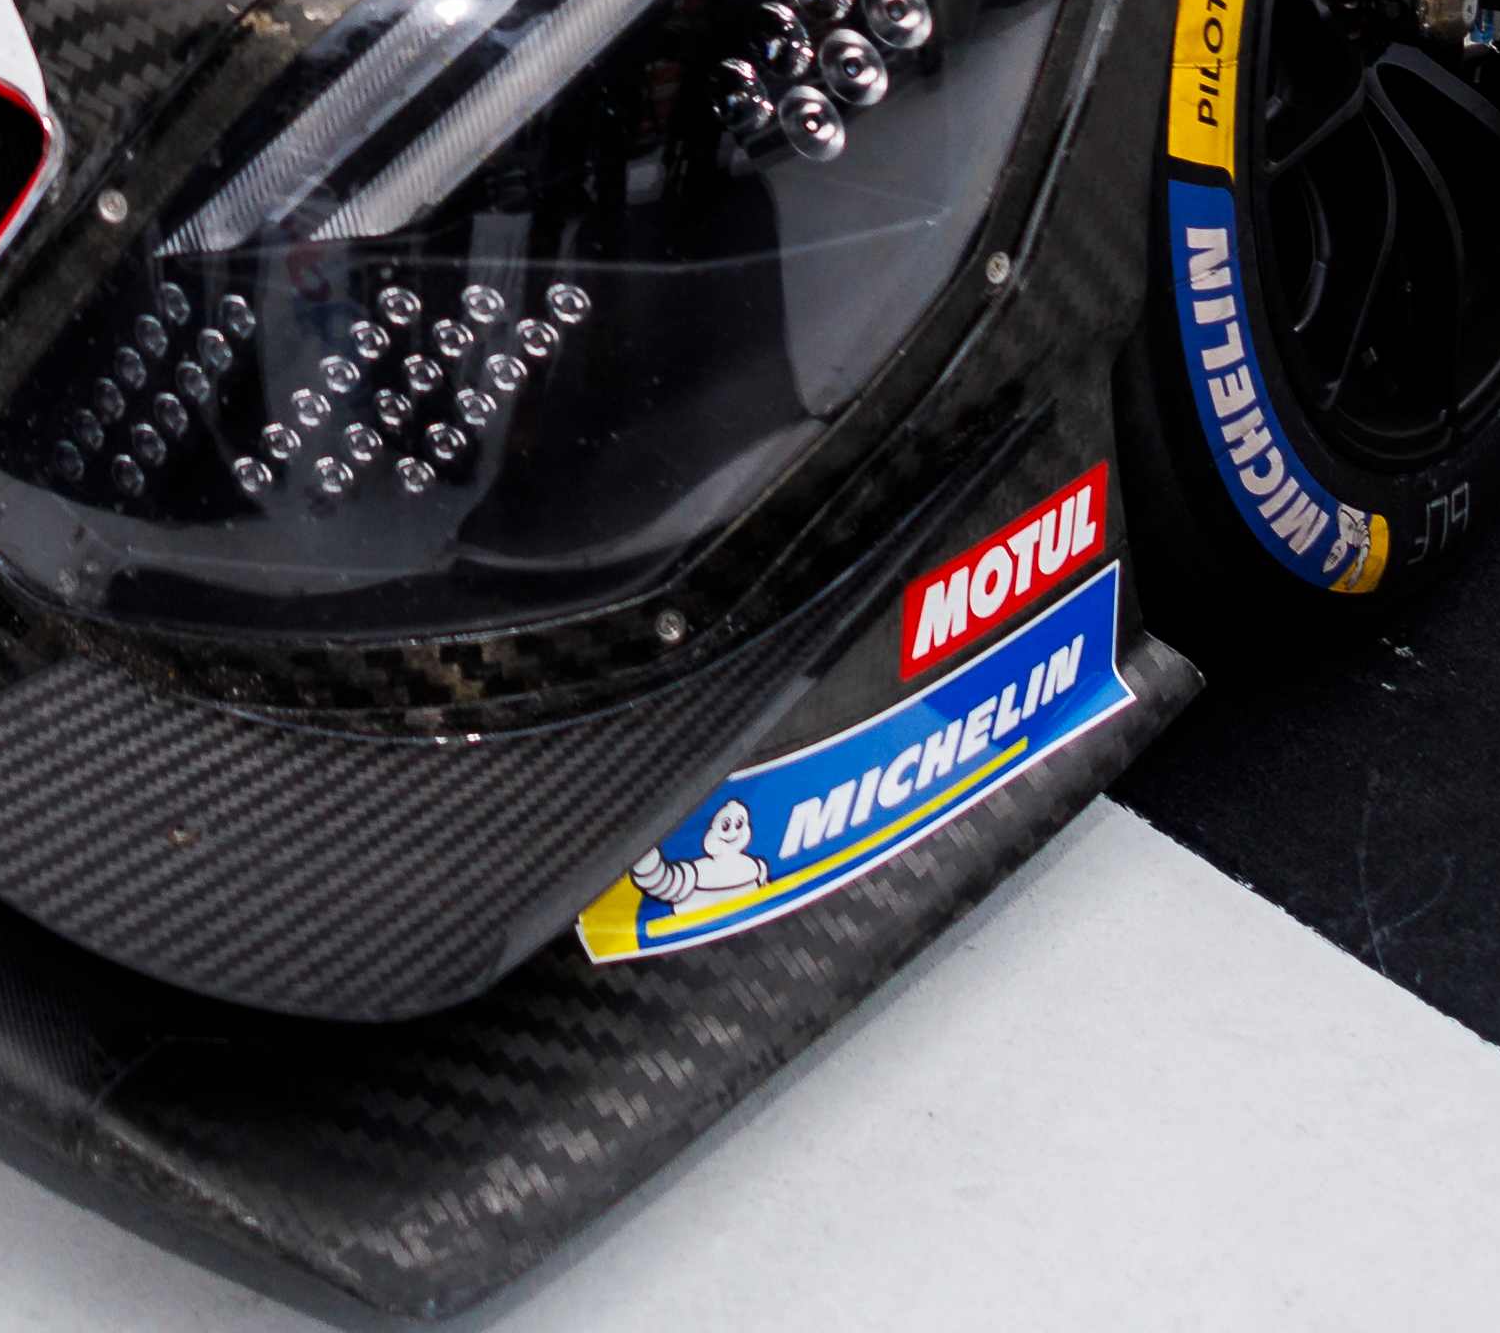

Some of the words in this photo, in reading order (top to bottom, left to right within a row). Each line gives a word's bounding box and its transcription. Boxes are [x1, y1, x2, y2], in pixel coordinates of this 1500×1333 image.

[1183, 226, 1330, 555] MICHELIN
[911, 483, 1099, 660] MOTUL
[778, 633, 1085, 860] MICHELIN
